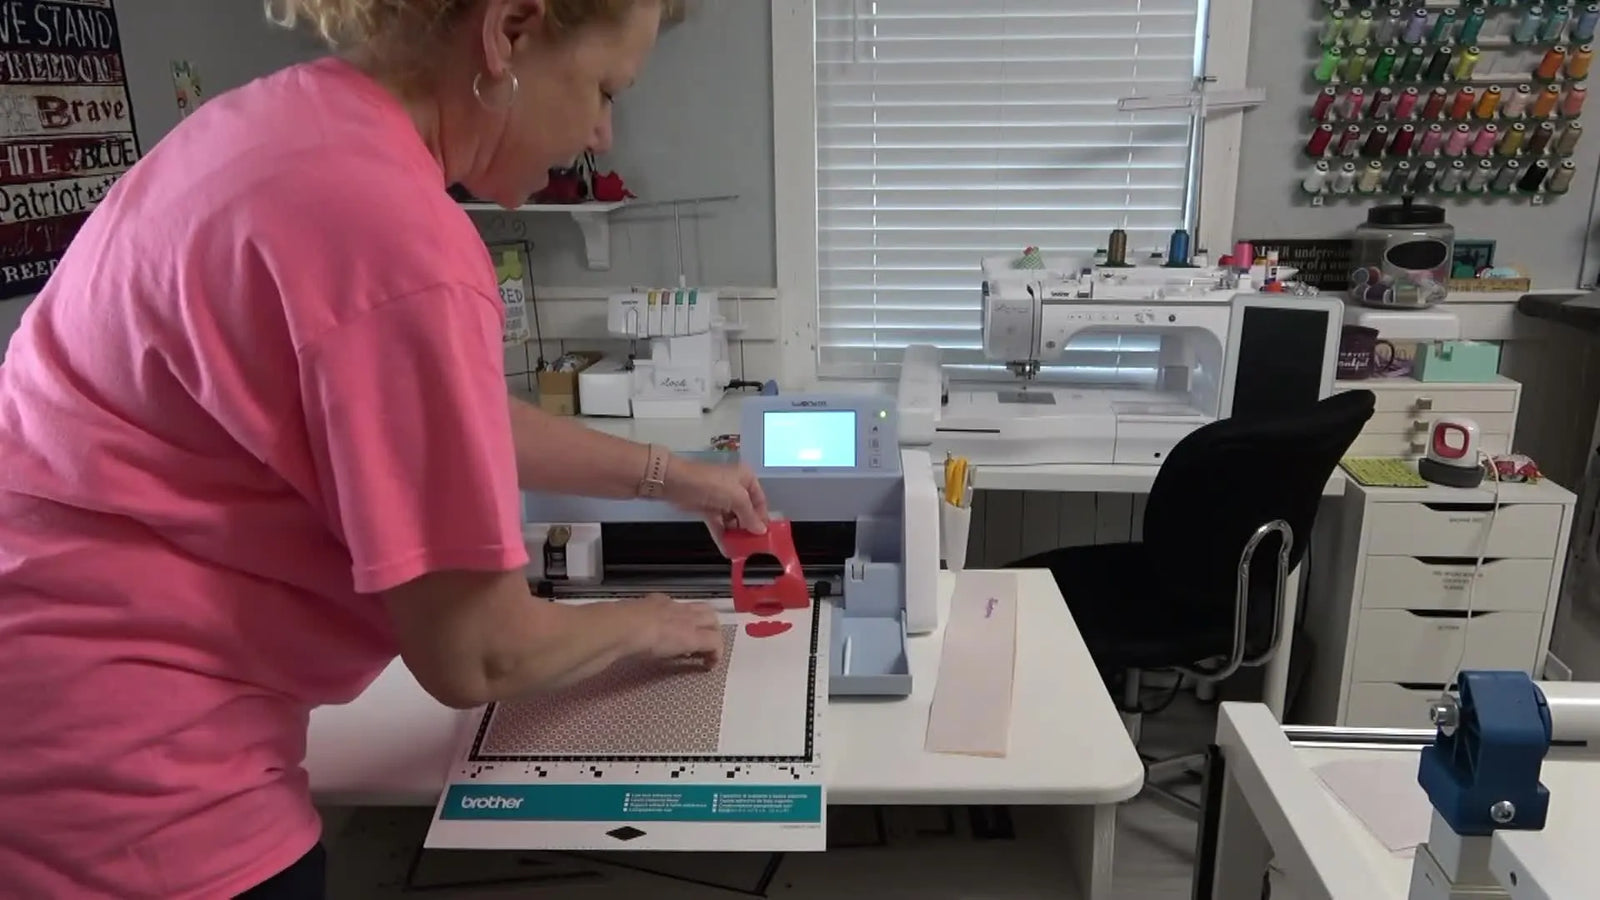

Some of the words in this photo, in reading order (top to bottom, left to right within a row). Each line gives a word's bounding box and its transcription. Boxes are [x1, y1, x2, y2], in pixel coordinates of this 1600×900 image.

[35, 4, 113, 48] STAND
[34, 96, 125, 129] Brave
[81, 138, 136, 170] BLUE
[0, 182, 85, 222] Patriot
[461, 795, 524, 809] brother
